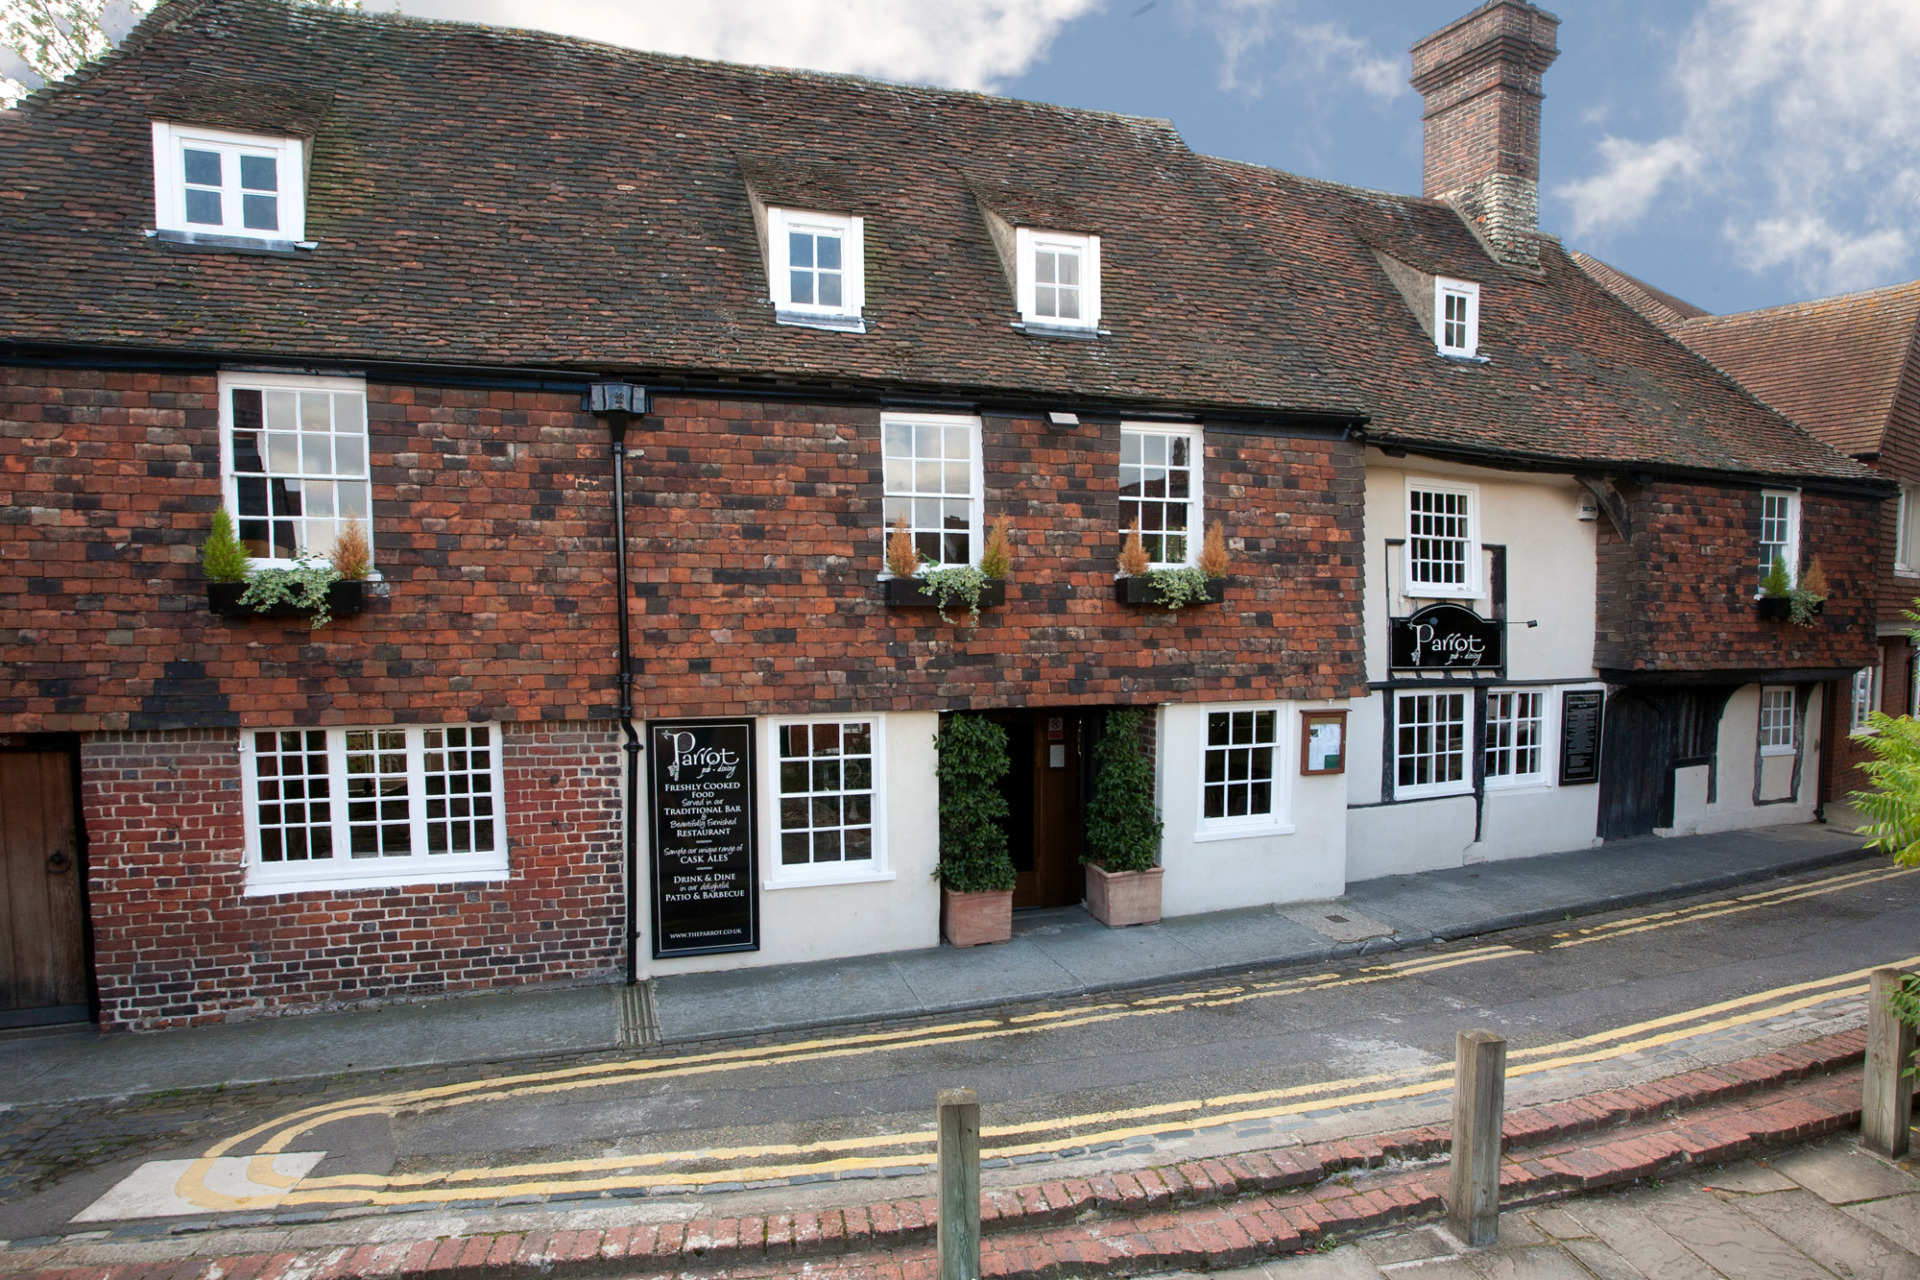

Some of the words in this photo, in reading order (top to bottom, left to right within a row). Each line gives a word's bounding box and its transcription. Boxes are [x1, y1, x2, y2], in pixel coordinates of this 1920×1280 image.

[1408, 623, 1485, 664] Parrot
[662, 731, 740, 780] Parrot
[665, 784, 702, 792] FRESHLY
[703, 782, 741, 790] COOKED
[691, 791, 715, 799] FOOD
[664, 807, 722, 815] TRADITIONAL
[725, 805, 741, 813] BAR
[670, 819, 706, 829] Beautifully
[707, 817, 737, 825] Furnished
[676, 828, 731, 837] RESTAURANT
[663, 847, 687, 857] Sample
[698, 847, 717, 855] unique
[718, 846, 735, 855] range
[736, 843, 744, 851] of
[680, 856, 704, 864] CASK
[707, 854, 728, 862] ALES
[674, 876, 703, 884] DRINK
[704, 874, 712, 882] &
[714, 873, 736, 881] DINE
[700, 882, 729, 891] delightful
[665, 894, 691, 902] PATIO
[693, 892, 700, 900] &
[702, 890, 745, 899] BARBECUE
